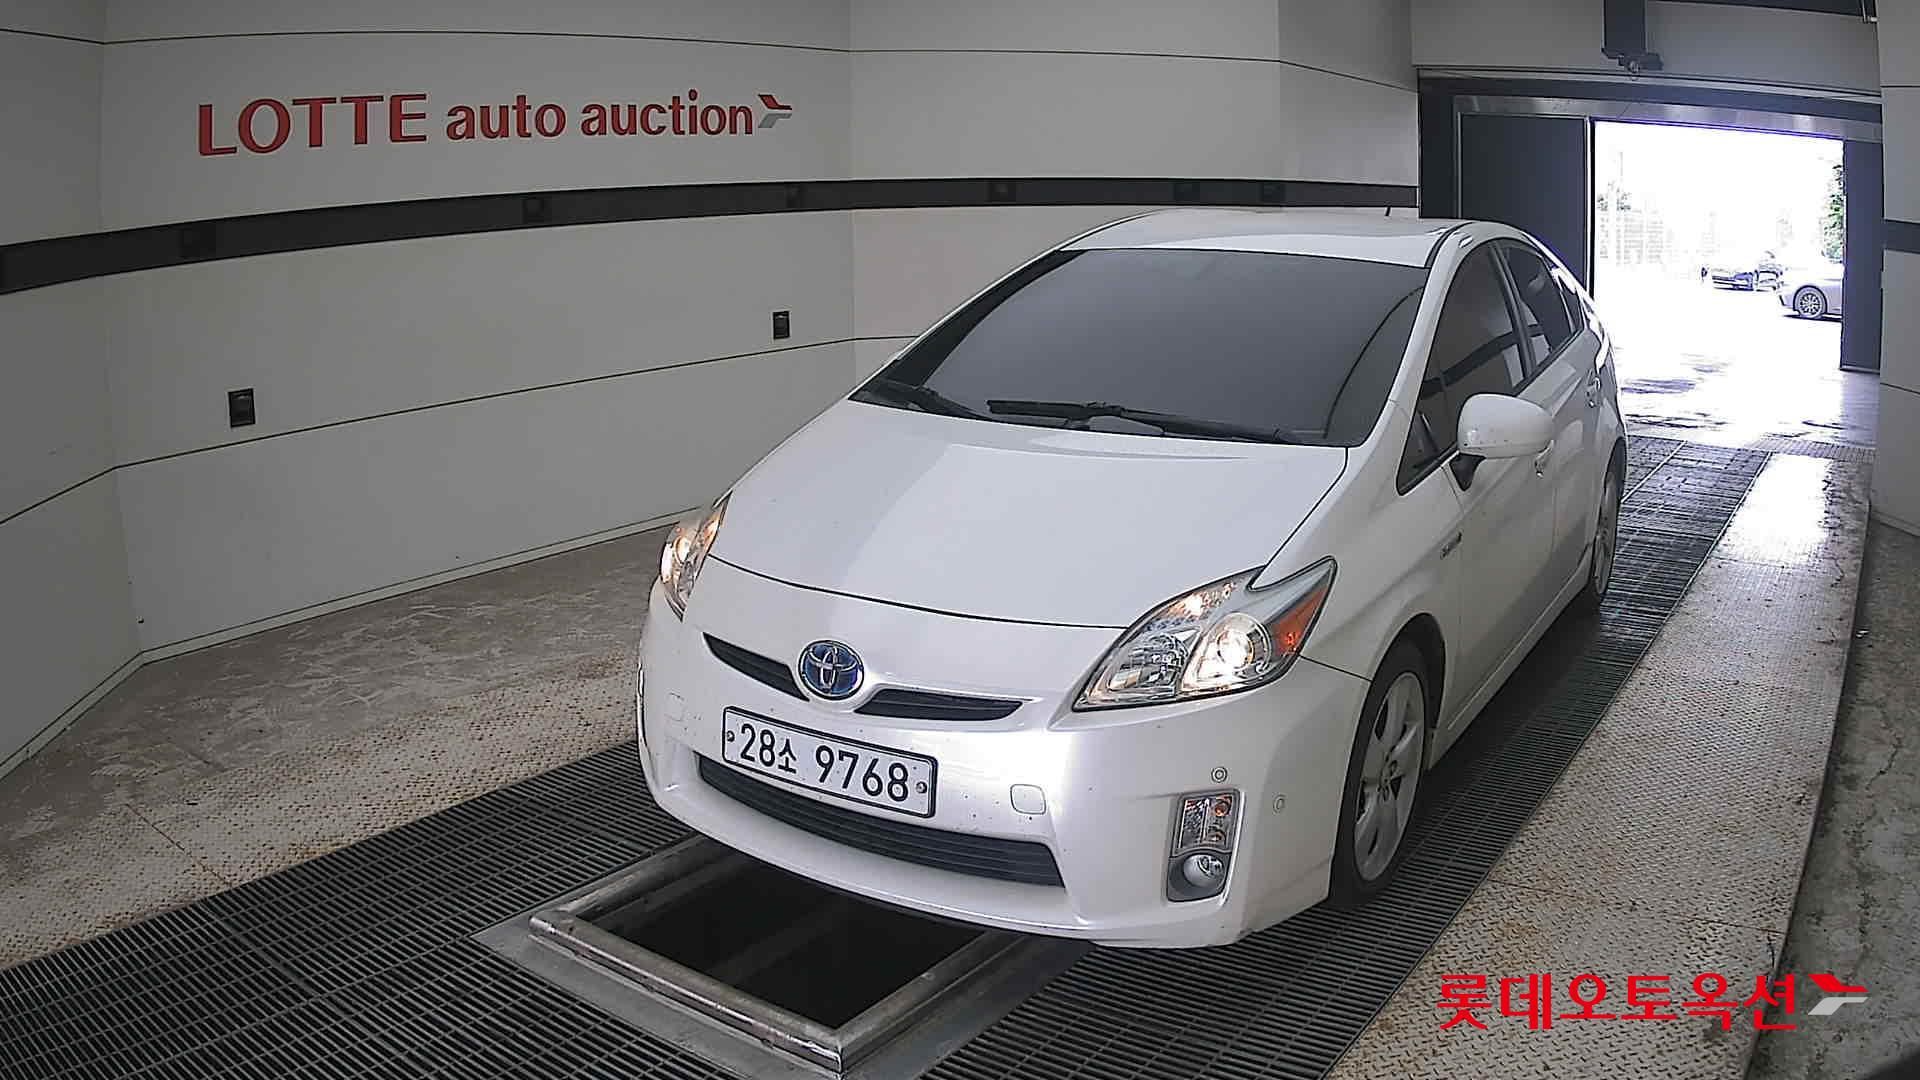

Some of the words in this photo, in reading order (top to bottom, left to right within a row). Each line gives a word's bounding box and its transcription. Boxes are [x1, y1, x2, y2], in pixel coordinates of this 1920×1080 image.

[199, 94, 427, 156] LOTTE
[446, 95, 567, 141] auto
[581, 89, 754, 136] auction
[740, 723, 797, 774] 28소
[815, 745, 909, 802] 9768
